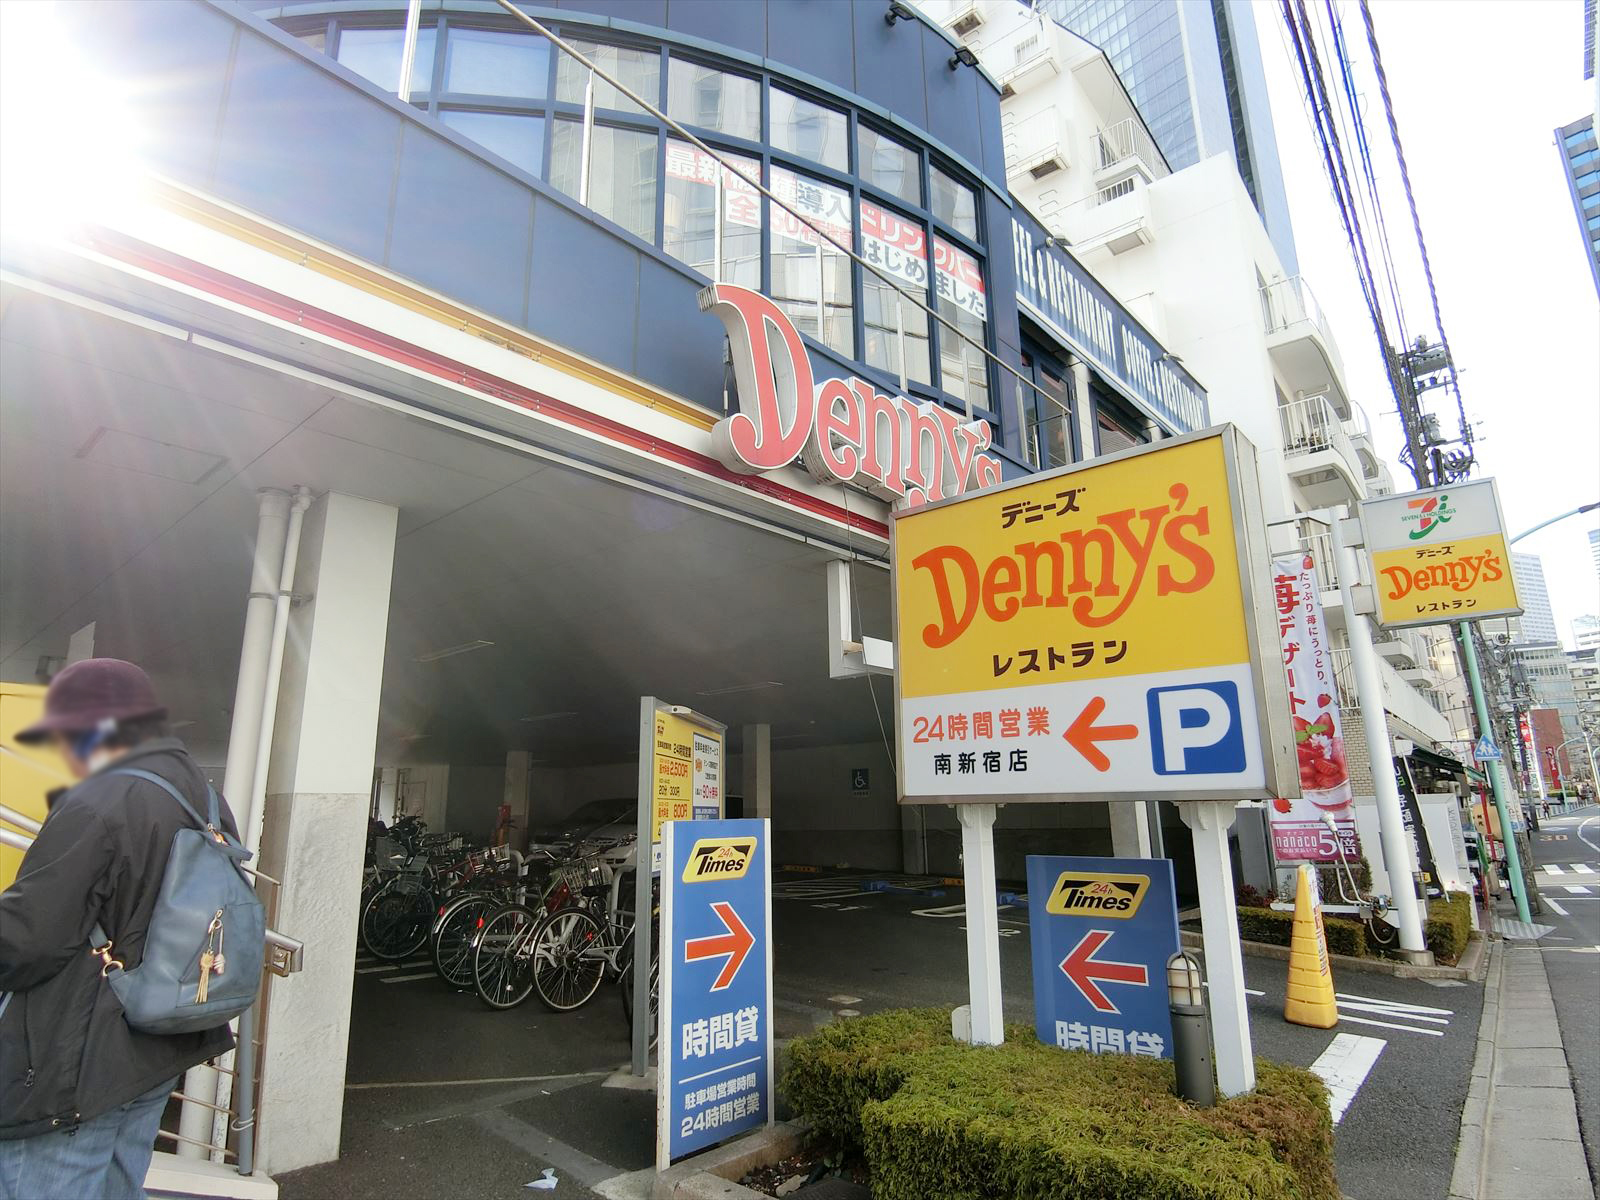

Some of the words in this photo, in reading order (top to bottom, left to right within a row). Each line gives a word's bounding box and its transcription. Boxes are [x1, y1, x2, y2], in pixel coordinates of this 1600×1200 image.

[862, 236, 984, 317] はじめました
[1036, 249, 1048, 300] &
[1046, 251, 1116, 360] RESTAURANT
[1122, 324, 1156, 396] COFFEE
[1001, 487, 1087, 529] デニーズ
[911, 482, 1215, 649] Denny's
[1416, 545, 1455, 559] デニーズ
[1380, 549, 1503, 600] Denny's
[1416, 599, 1477, 613] レストラン
[1273, 574, 1306, 715] 苺デザート
[1299, 571, 1328, 686] たっぷり苺にうっとり。
[993, 640, 1127, 677] レストラン
[912, 706, 1050, 744] 24時間営業
[933, 749, 1028, 776] 南新宿店
[1276, 836, 1318, 848] nanaco
[696, 853, 746, 876] Times
[1063, 888, 1132, 911] Times
[682, 1006, 759, 1060] 時間貸
[1055, 1020, 1165, 1059] 時間貸
[684, 1071, 756, 1110] 駐車場営業時間
[681, 1092, 760, 1138] 24時間営業
